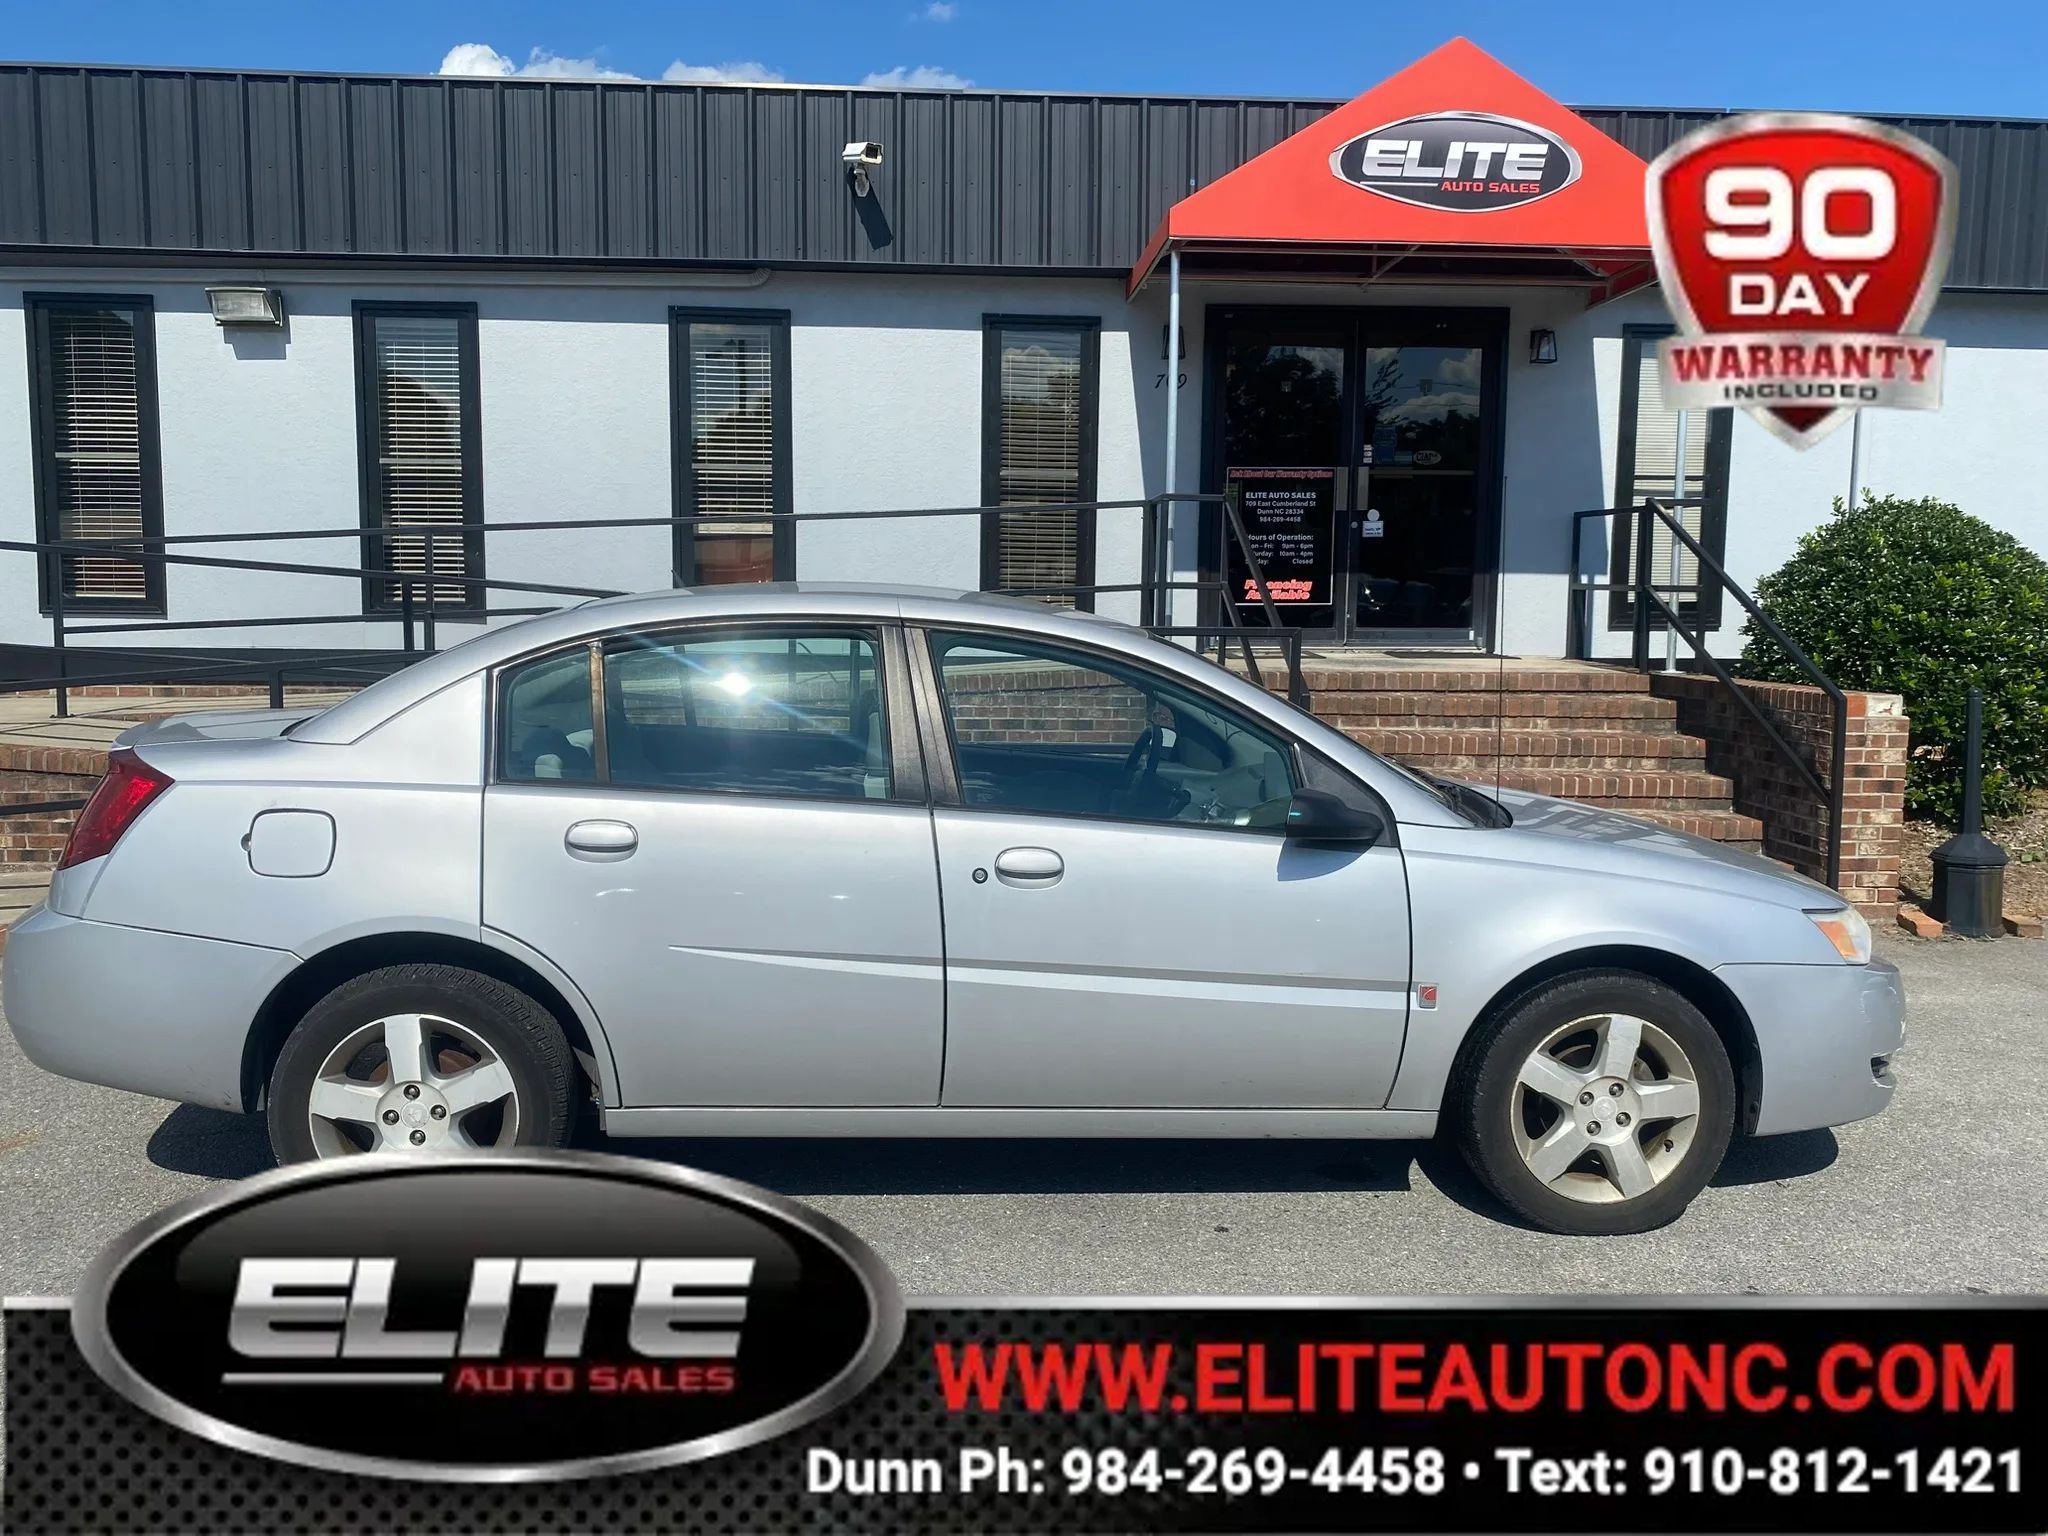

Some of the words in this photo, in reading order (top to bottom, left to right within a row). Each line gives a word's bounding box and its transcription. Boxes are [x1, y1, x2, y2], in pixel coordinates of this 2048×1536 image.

[1361, 139, 1549, 181] ELITE
[1441, 181, 1484, 193] AUTO
[1488, 181, 1541, 194] SALES
[1154, 373, 1188, 390] 79
[1276, 533, 1314, 542] Operation:
